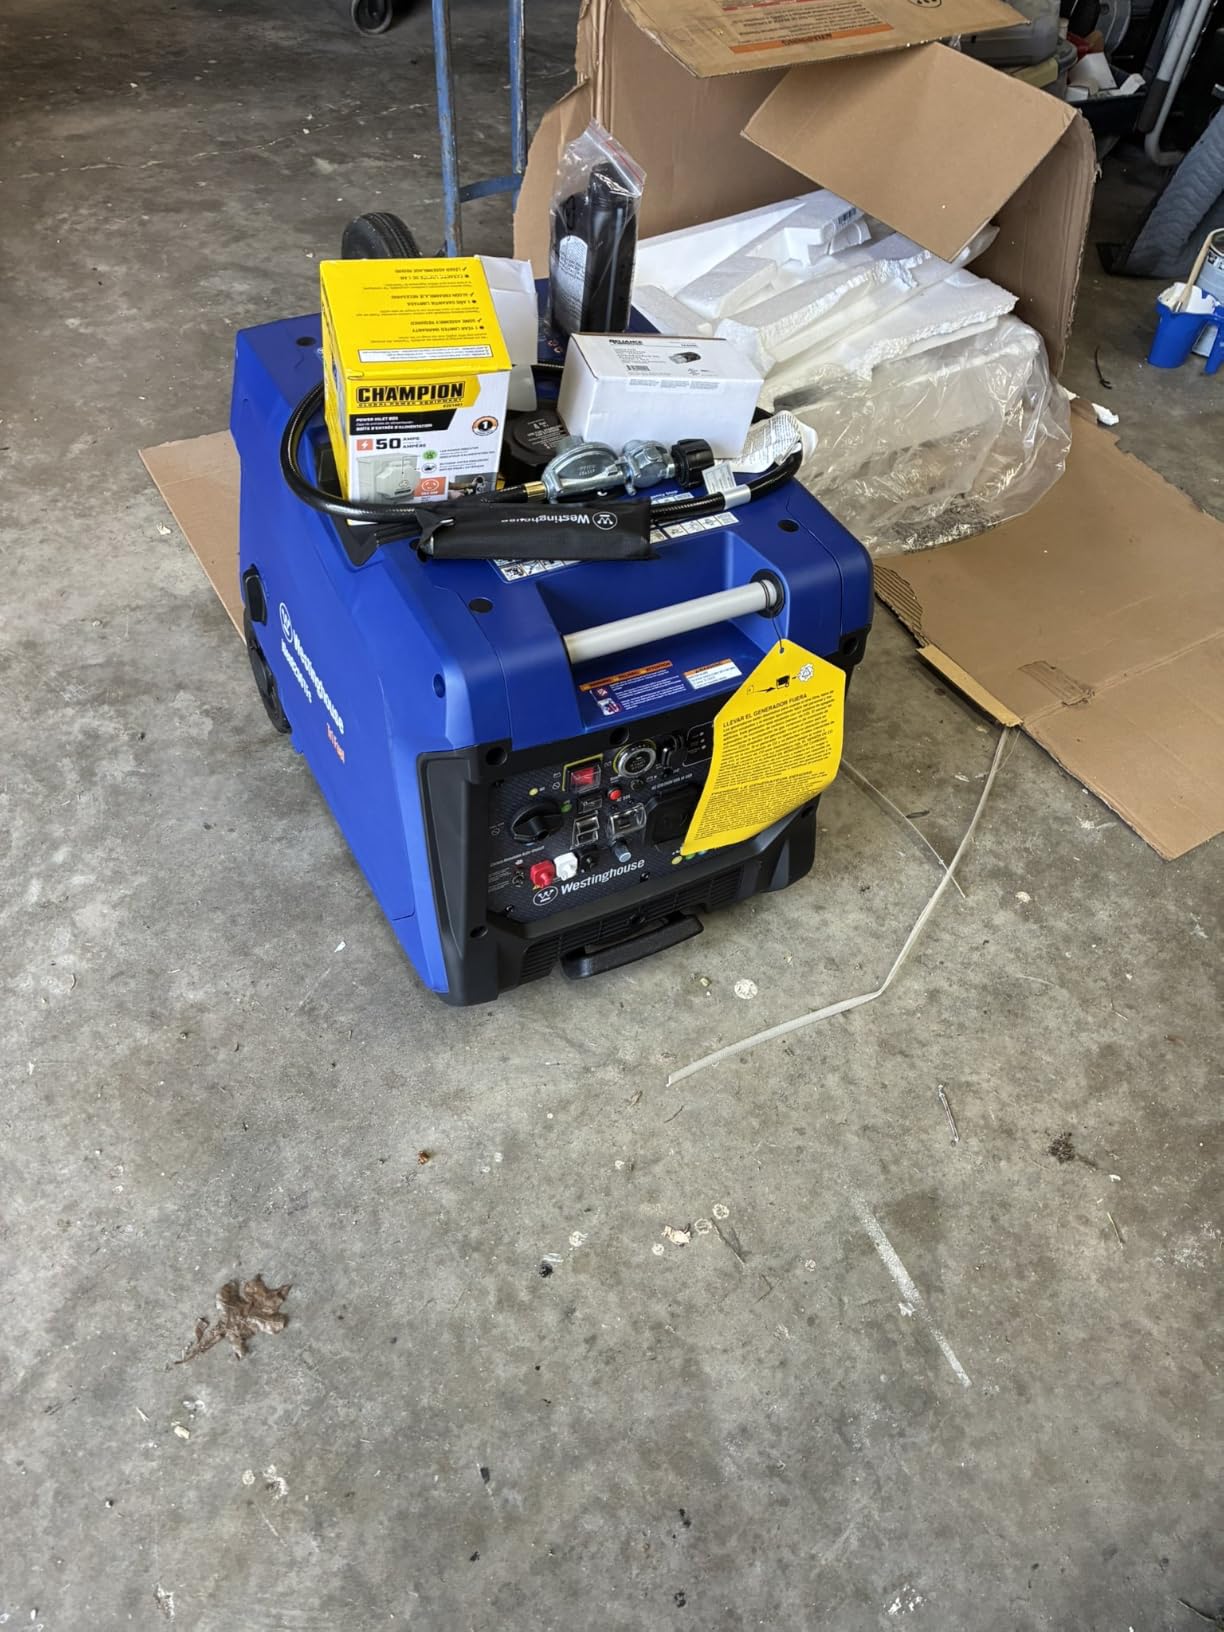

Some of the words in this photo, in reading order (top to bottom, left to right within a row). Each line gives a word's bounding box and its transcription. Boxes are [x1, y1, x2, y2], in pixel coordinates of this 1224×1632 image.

[358, 383, 464, 403] CHAMPION
[482, 421, 489, 429] 1
[376, 438, 401, 449] 50
[723, 715, 745, 727] LLEVAR
[753, 700, 788, 717] GENERADOR
[789, 693, 807, 703] FUERA
[562, 859, 645, 895] Westinghouse
